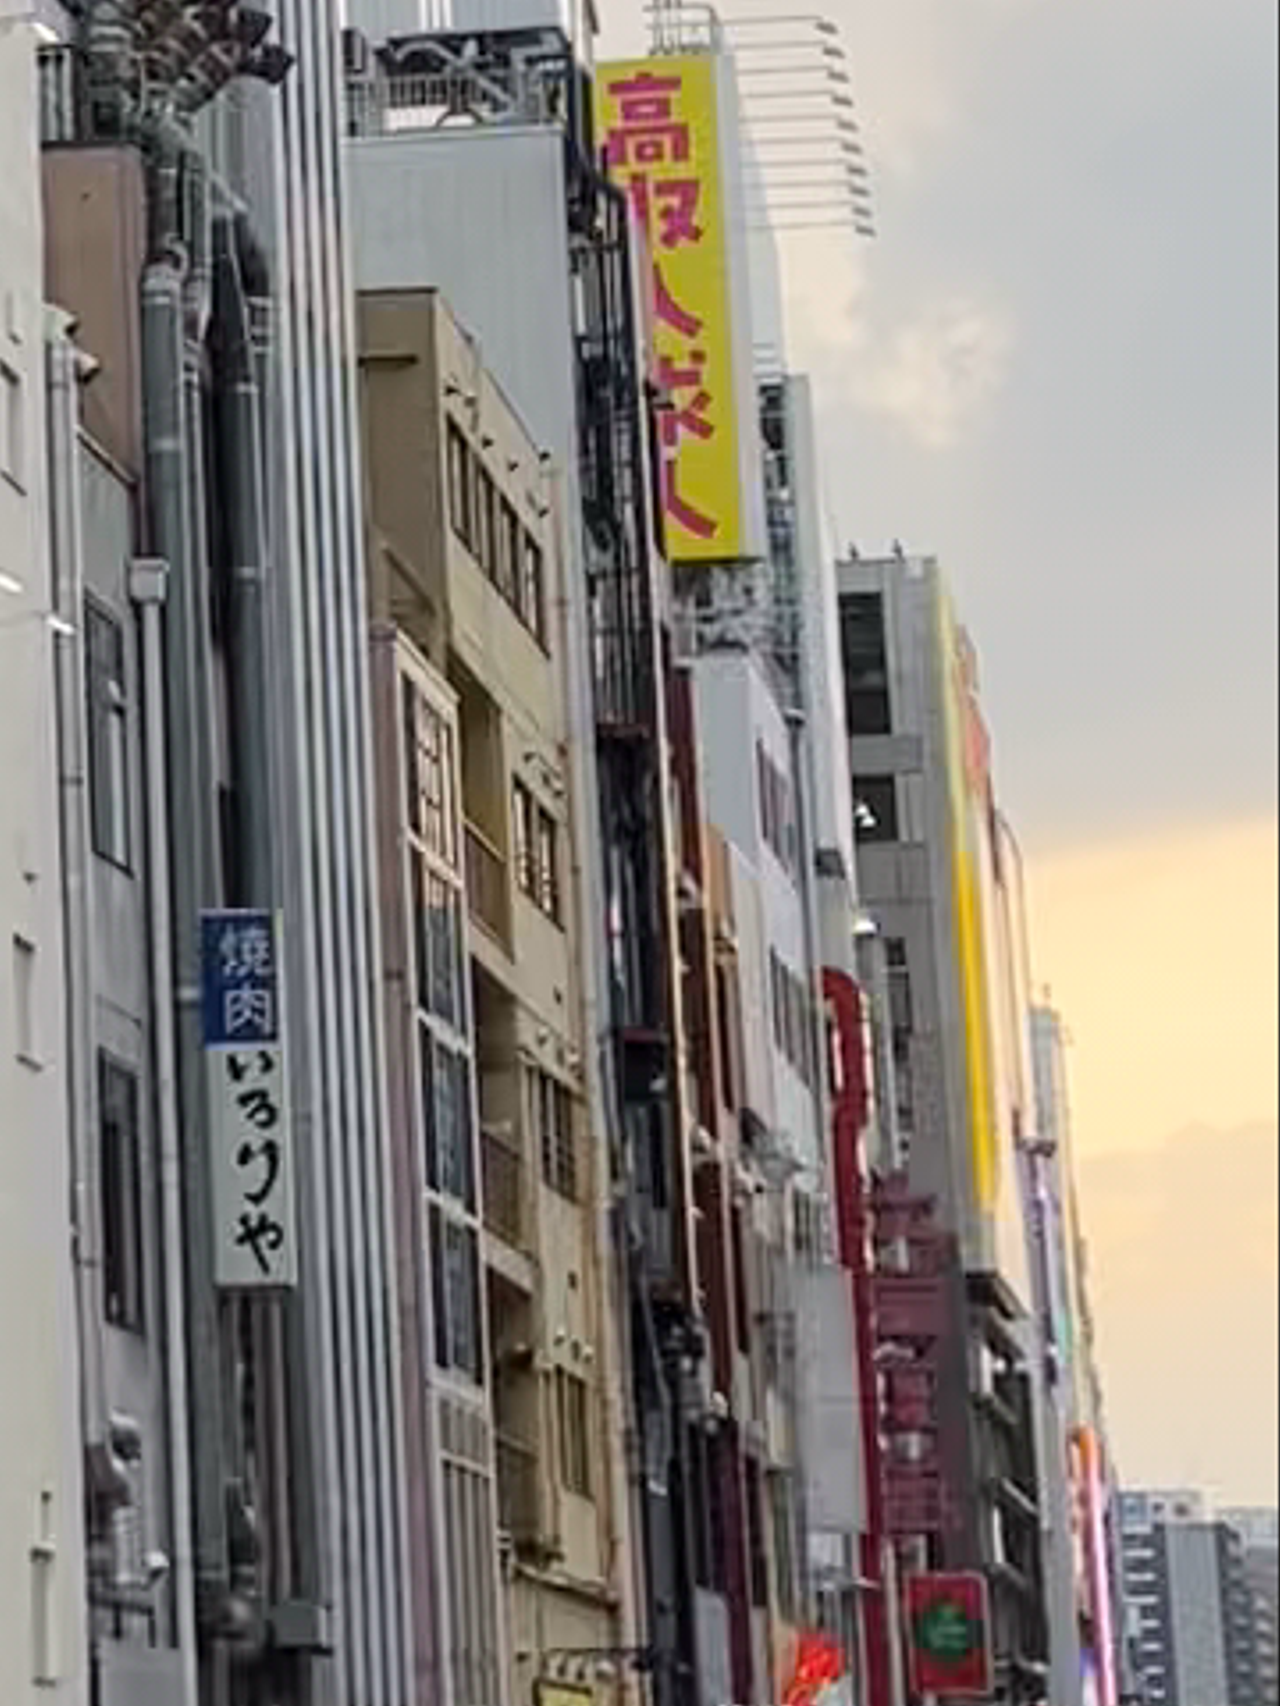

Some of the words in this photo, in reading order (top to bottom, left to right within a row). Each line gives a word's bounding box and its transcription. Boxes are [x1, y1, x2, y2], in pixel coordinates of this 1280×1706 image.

[220, 924, 274, 1035] 焼肉
[226, 1049, 284, 1276] いろりや
